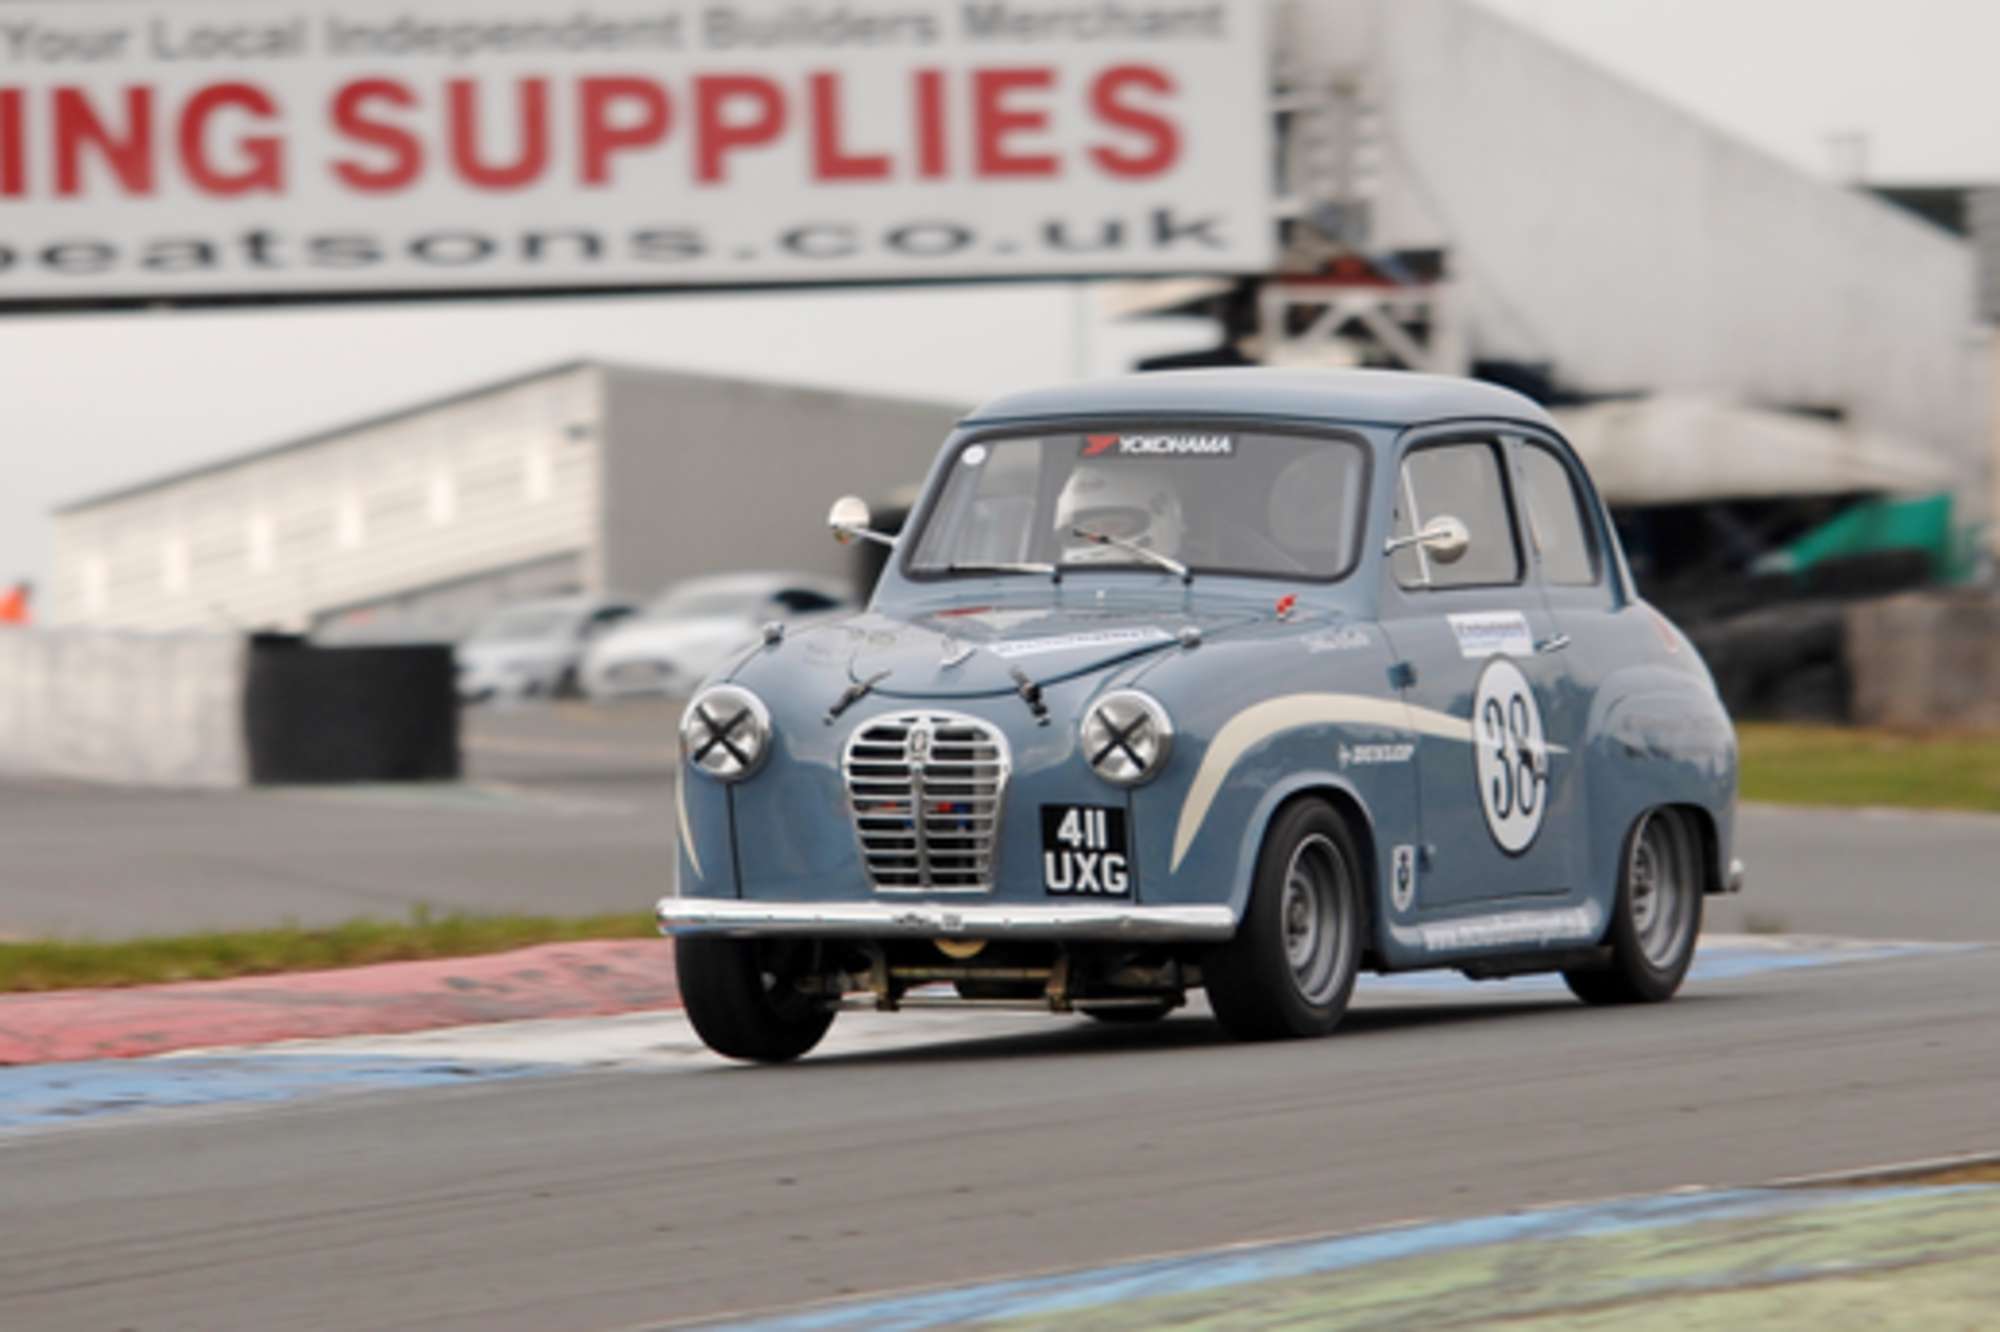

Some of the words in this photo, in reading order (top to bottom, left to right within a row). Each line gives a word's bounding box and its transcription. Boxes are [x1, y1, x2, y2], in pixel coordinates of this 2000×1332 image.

[4, 18, 130, 62] Your
[149, 14, 305, 60] Local
[325, 9, 685, 58] Independent
[704, 3, 938, 48] Builders
[962, 0, 1228, 41] Merchant
[328, 64, 1183, 193] SUPPLIES
[0, 208, 1228, 272] eatsons.co.uk
[1119, 435, 1231, 453] YOKOHAMA
[1483, 692, 1538, 820] 38
[1057, 809, 1106, 849] 411
[1045, 852, 1129, 893] UXG
